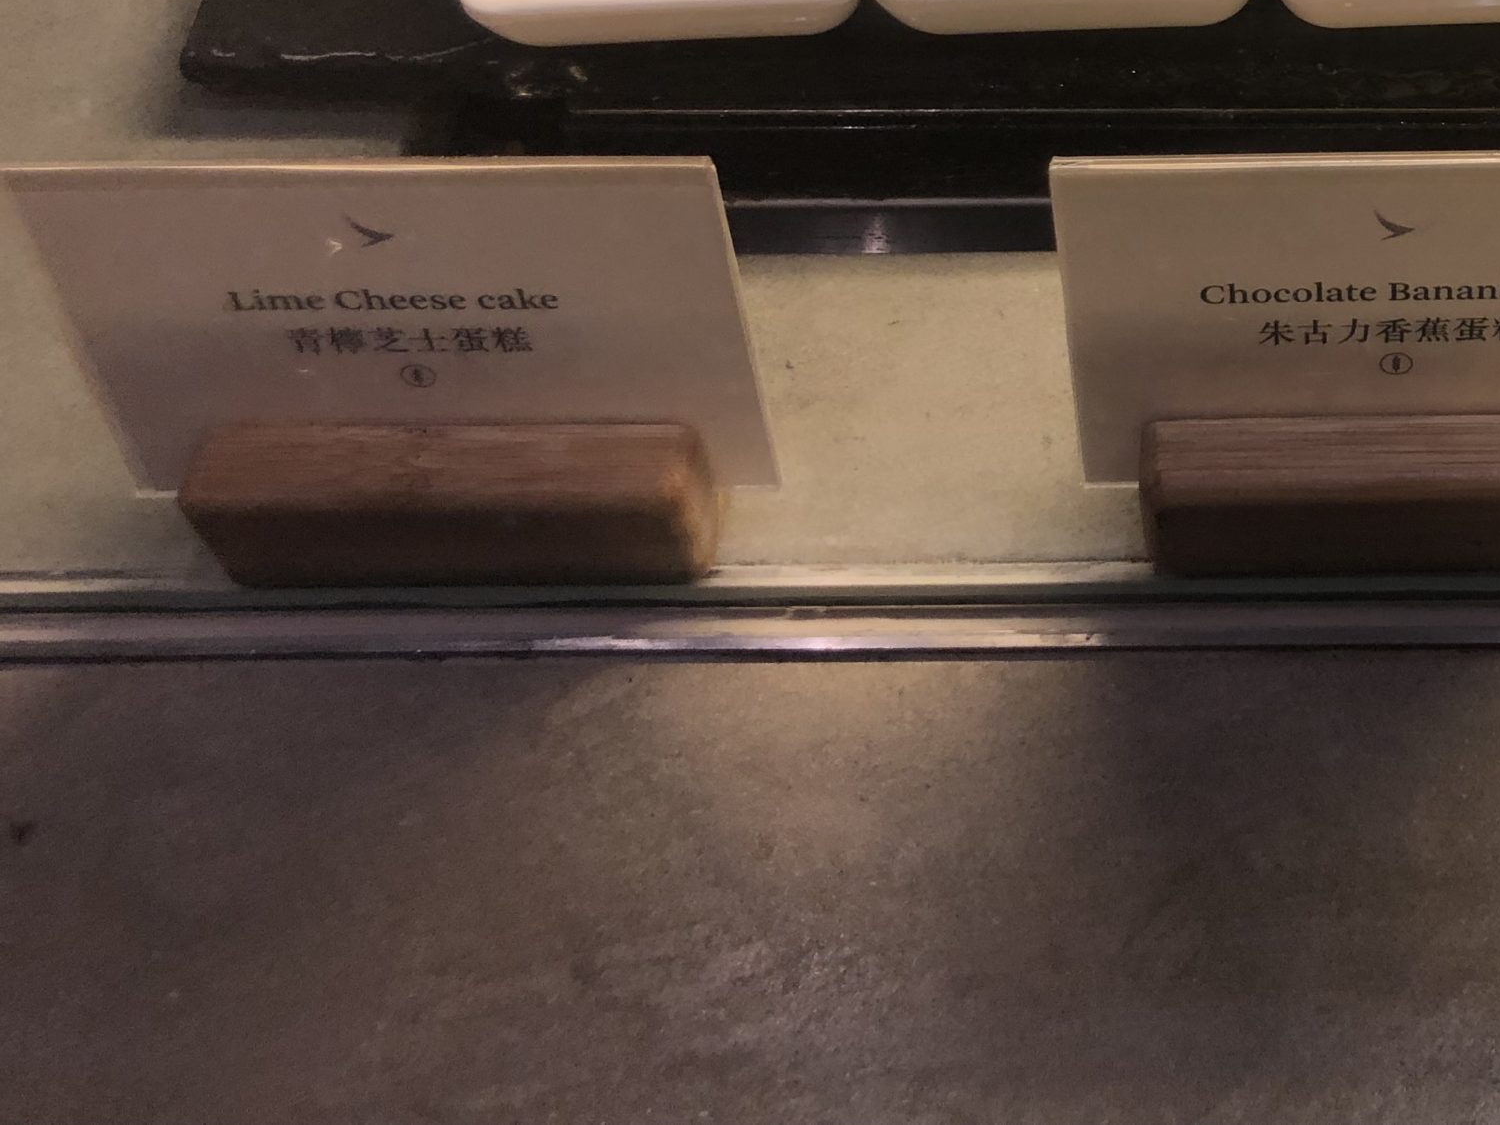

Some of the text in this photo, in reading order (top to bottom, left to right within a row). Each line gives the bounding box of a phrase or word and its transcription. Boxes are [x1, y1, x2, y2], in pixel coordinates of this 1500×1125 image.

[227, 288, 559, 311] Lime Cheese cake
[1200, 282, 1377, 305] Chocolate
[286, 326, 534, 355] 青檸芝士蛋糕
